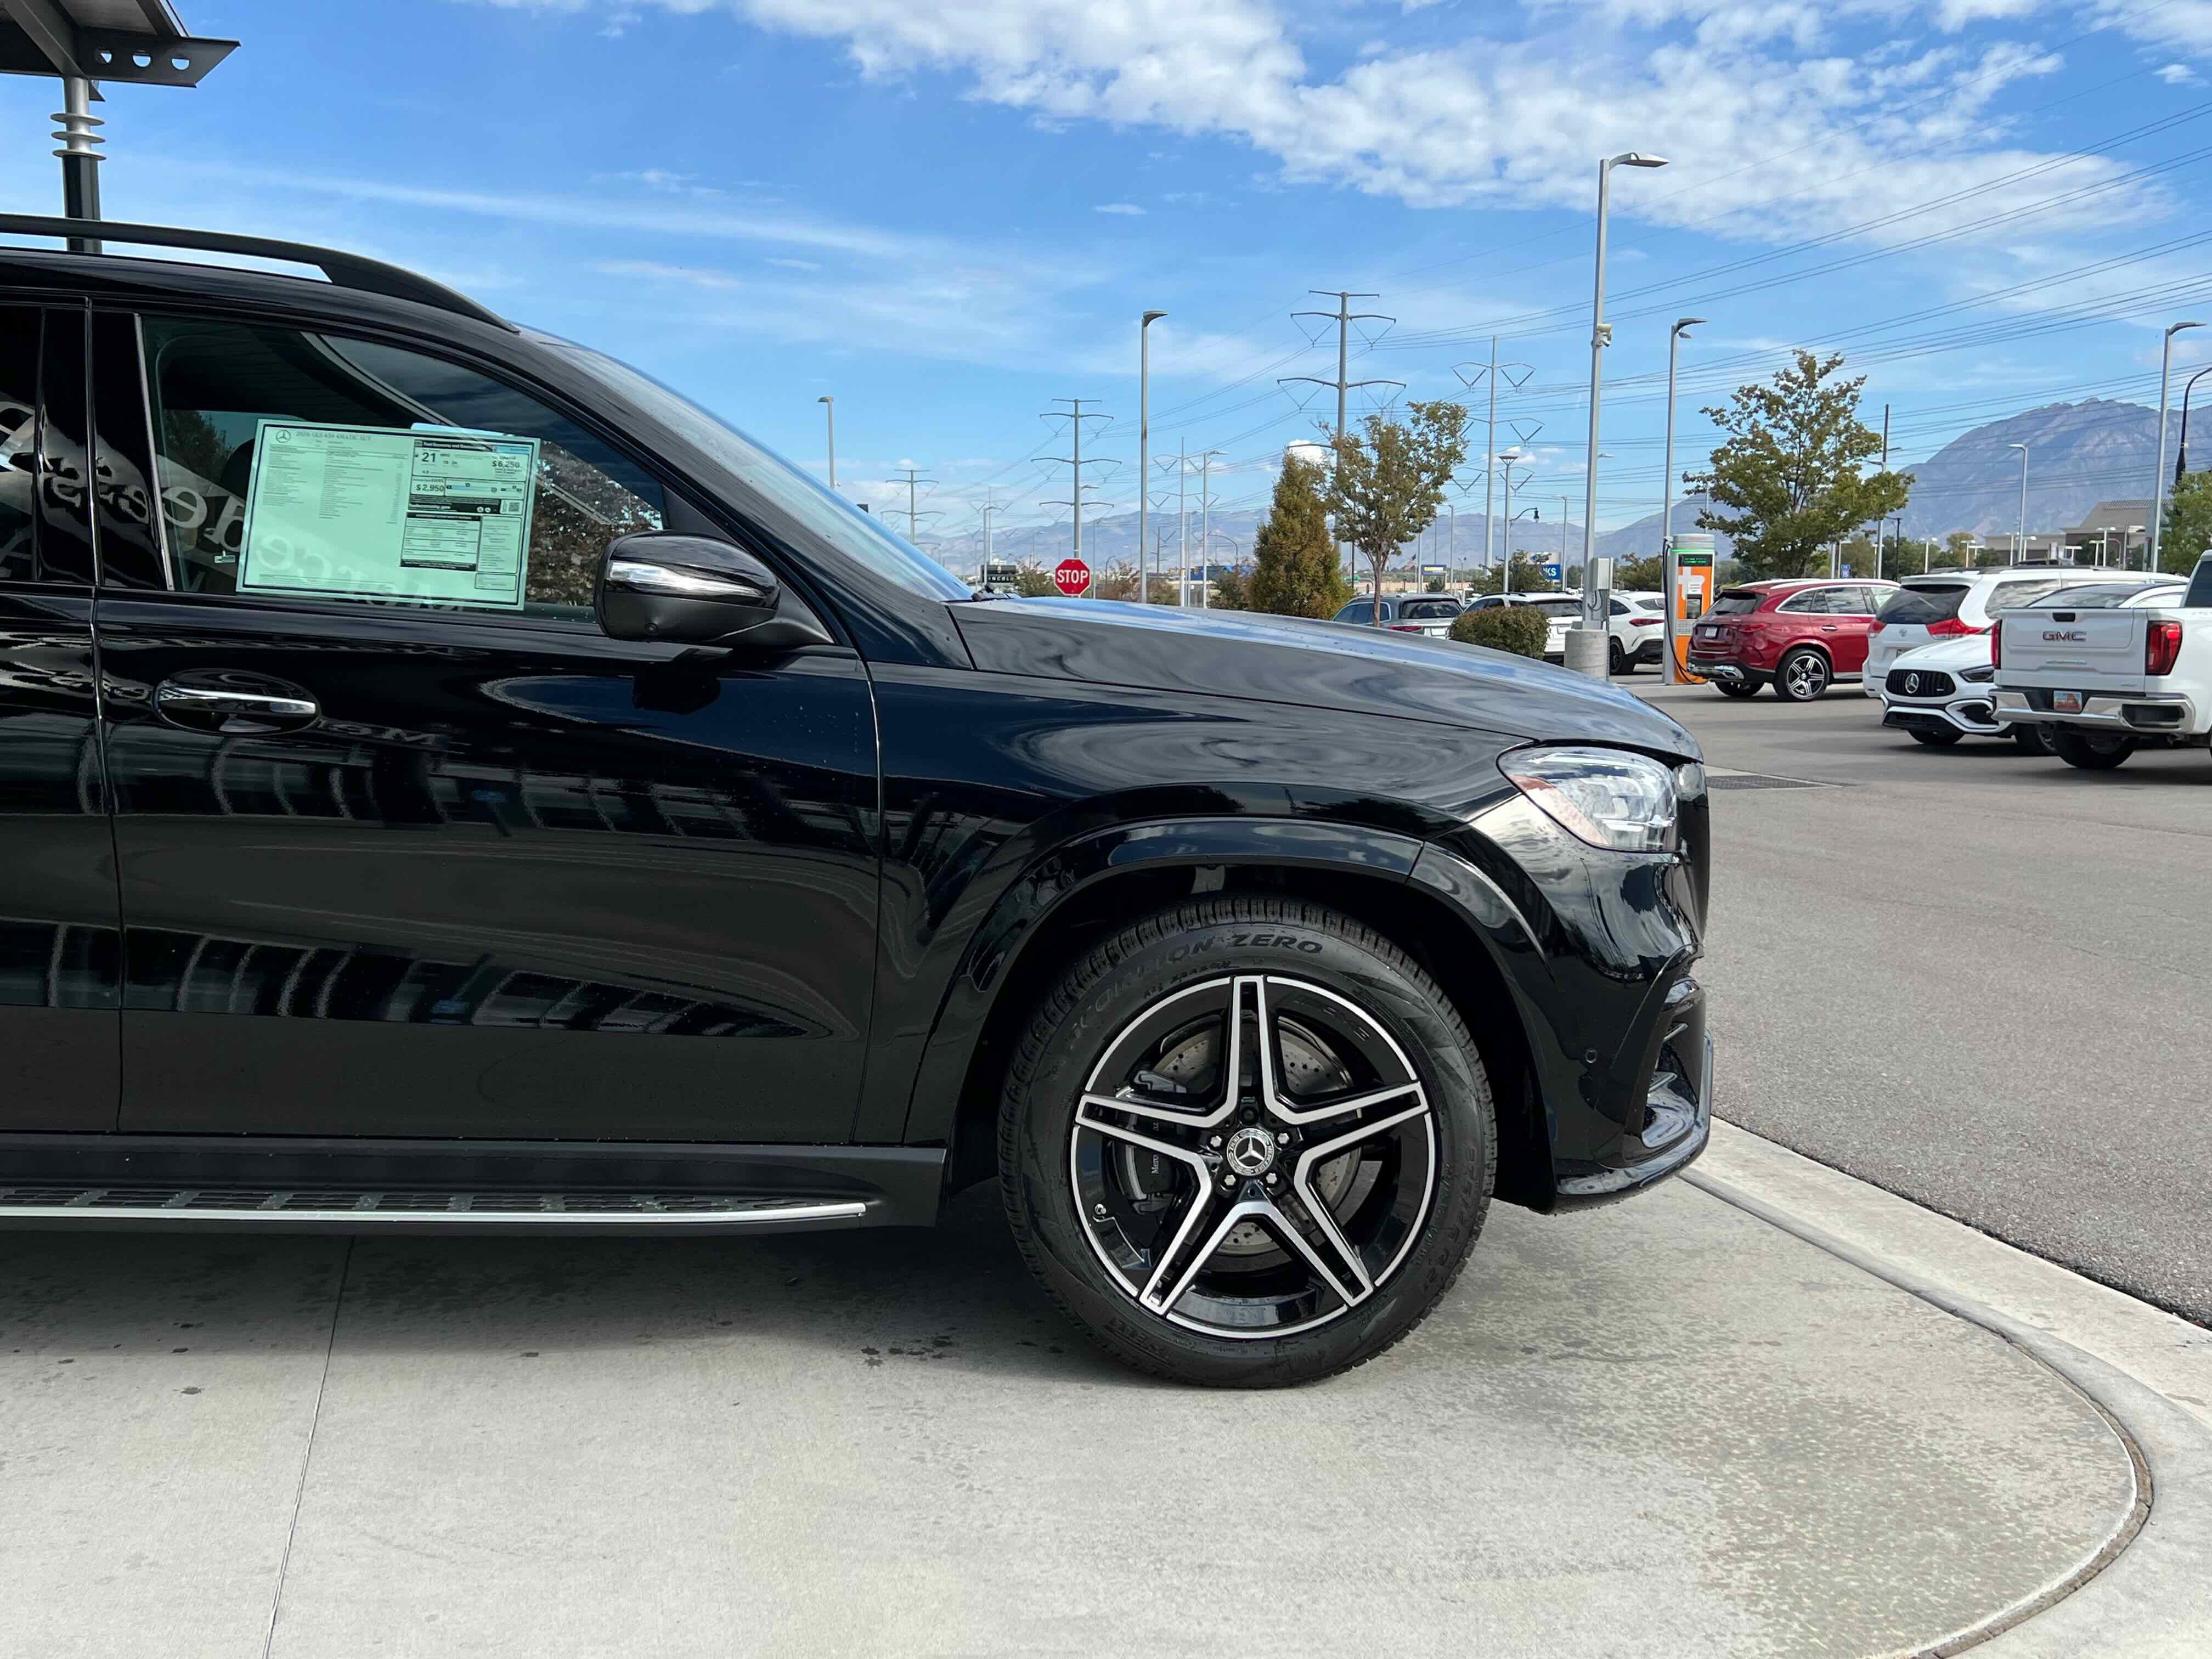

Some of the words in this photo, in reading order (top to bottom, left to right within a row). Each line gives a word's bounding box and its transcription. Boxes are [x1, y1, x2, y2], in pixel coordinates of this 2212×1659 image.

[421, 452, 436, 463] 21
[416, 483, 445, 493] $2,950
[1057, 569, 1089, 584] STOP
[2042, 630, 2087, 641] GMC
[1228, 934, 1323, 955] ZERO
